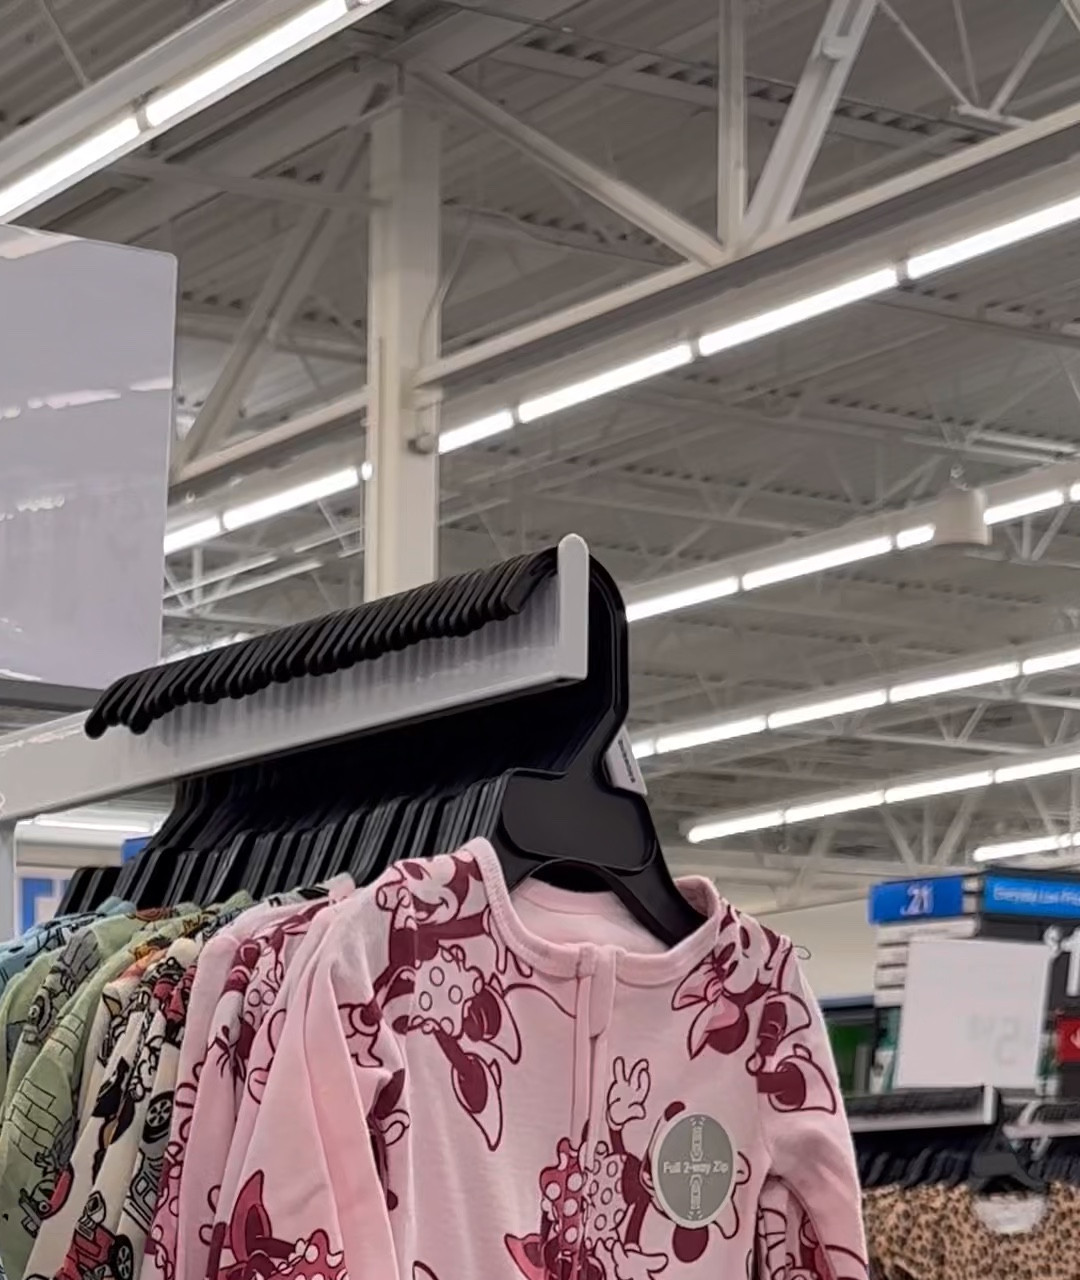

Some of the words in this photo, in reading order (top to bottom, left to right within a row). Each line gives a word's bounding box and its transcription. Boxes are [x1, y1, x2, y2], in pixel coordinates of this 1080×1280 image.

[663, 1161, 682, 1174] Full
[683, 1162, 711, 1175] 2-way
[713, 1160, 729, 1174] Zip
